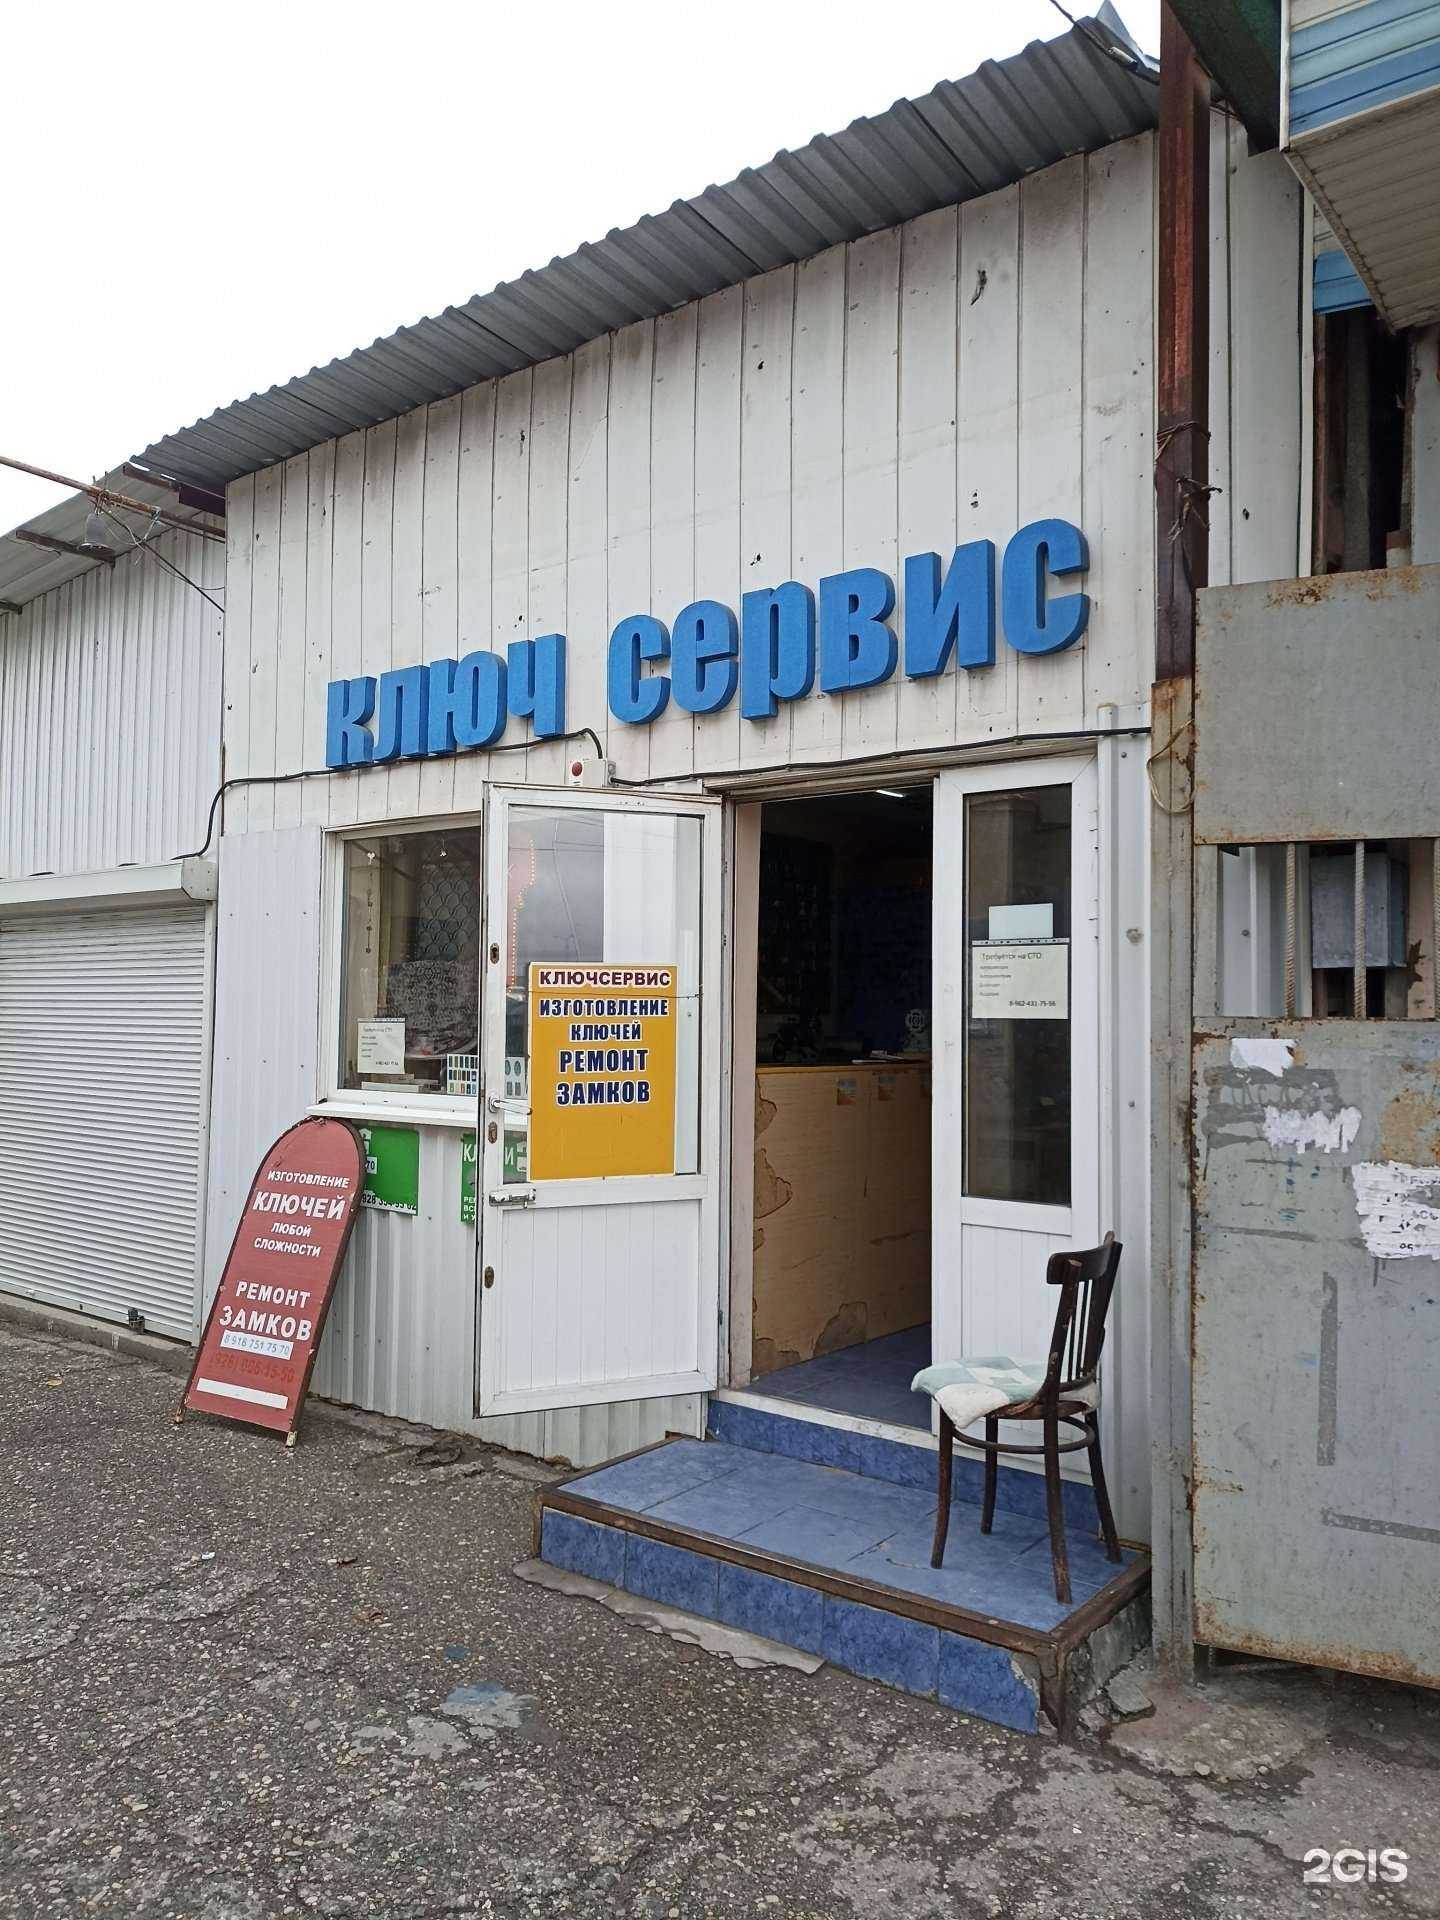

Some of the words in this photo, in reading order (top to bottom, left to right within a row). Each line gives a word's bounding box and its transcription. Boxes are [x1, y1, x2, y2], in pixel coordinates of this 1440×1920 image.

[539, 970, 671, 986] КЛЮЧСЕРВИС
[539, 999, 668, 1016] ИЗГОТОВЛЕНИЕ
[571, 1020, 641, 1041] КЛЮЧЕЙ
[559, 1049, 649, 1073] РЕМОНТ
[556, 1080, 650, 1106] ЗАМКОВ
[267, 1170, 350, 1189] ИЗГОТОВЛЕНИЕ
[252, 1191, 346, 1221] КЛЮЧЕЙ
[271, 1221, 311, 1238] ЛЮБОЙ
[254, 1237, 321, 1257] СЛОЖНОСТИ
[235, 1280, 311, 1309] РЕМОНТ
[219, 1305, 312, 1341] ЗАМКОВ
[224, 1334, 230, 1344] 8
[231, 1336, 247, 1347] 916
[249, 1339, 265, 1350] 751
[266, 1341, 277, 1353] 75
[279, 1344, 290, 1356] 70
